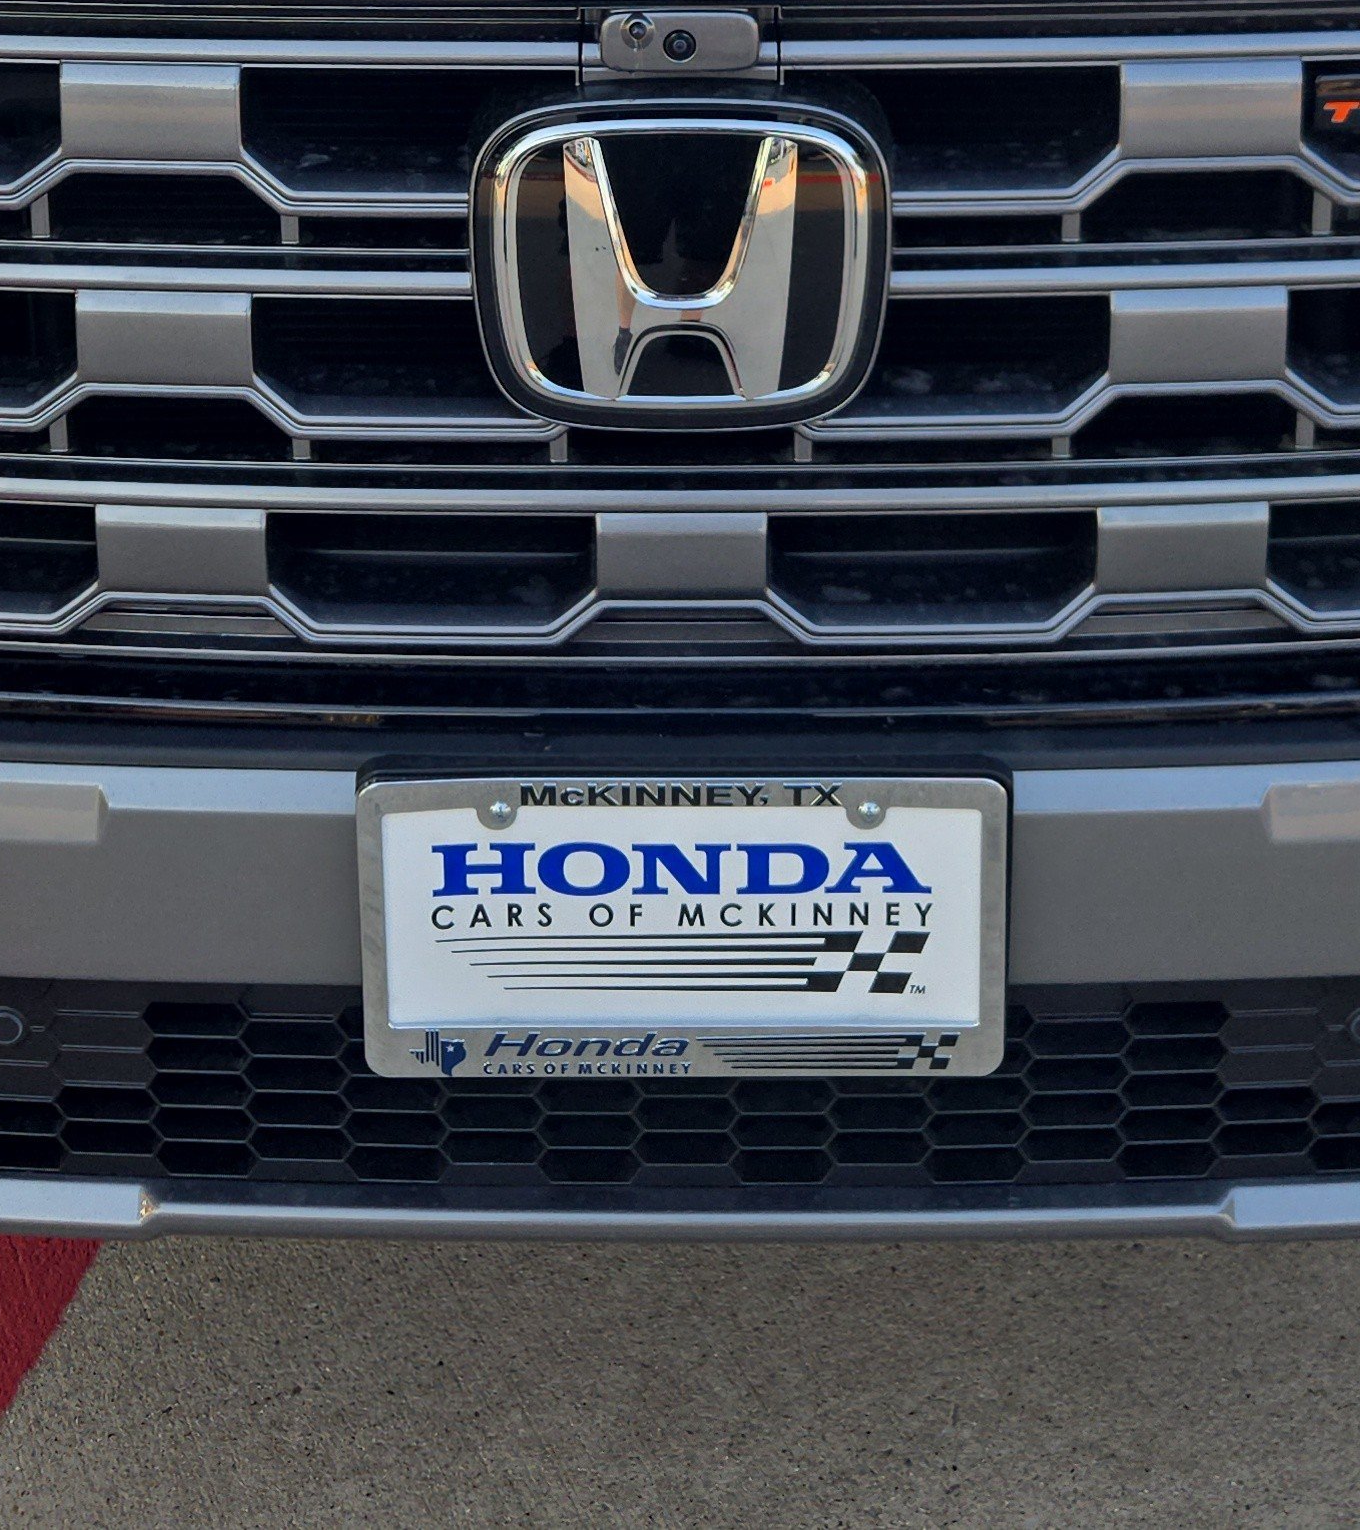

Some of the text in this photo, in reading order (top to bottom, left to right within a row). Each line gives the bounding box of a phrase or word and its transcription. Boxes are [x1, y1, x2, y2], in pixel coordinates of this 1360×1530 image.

[519, 782, 843, 807] McKINNEY, TX
[431, 841, 933, 898] HONDA
[431, 901, 933, 931] CARS OF MCKINNEY
[909, 984, 927, 995] TM
[483, 1030, 690, 1058] Honda
[482, 1061, 692, 1076] CARS OF MCKINNEY
